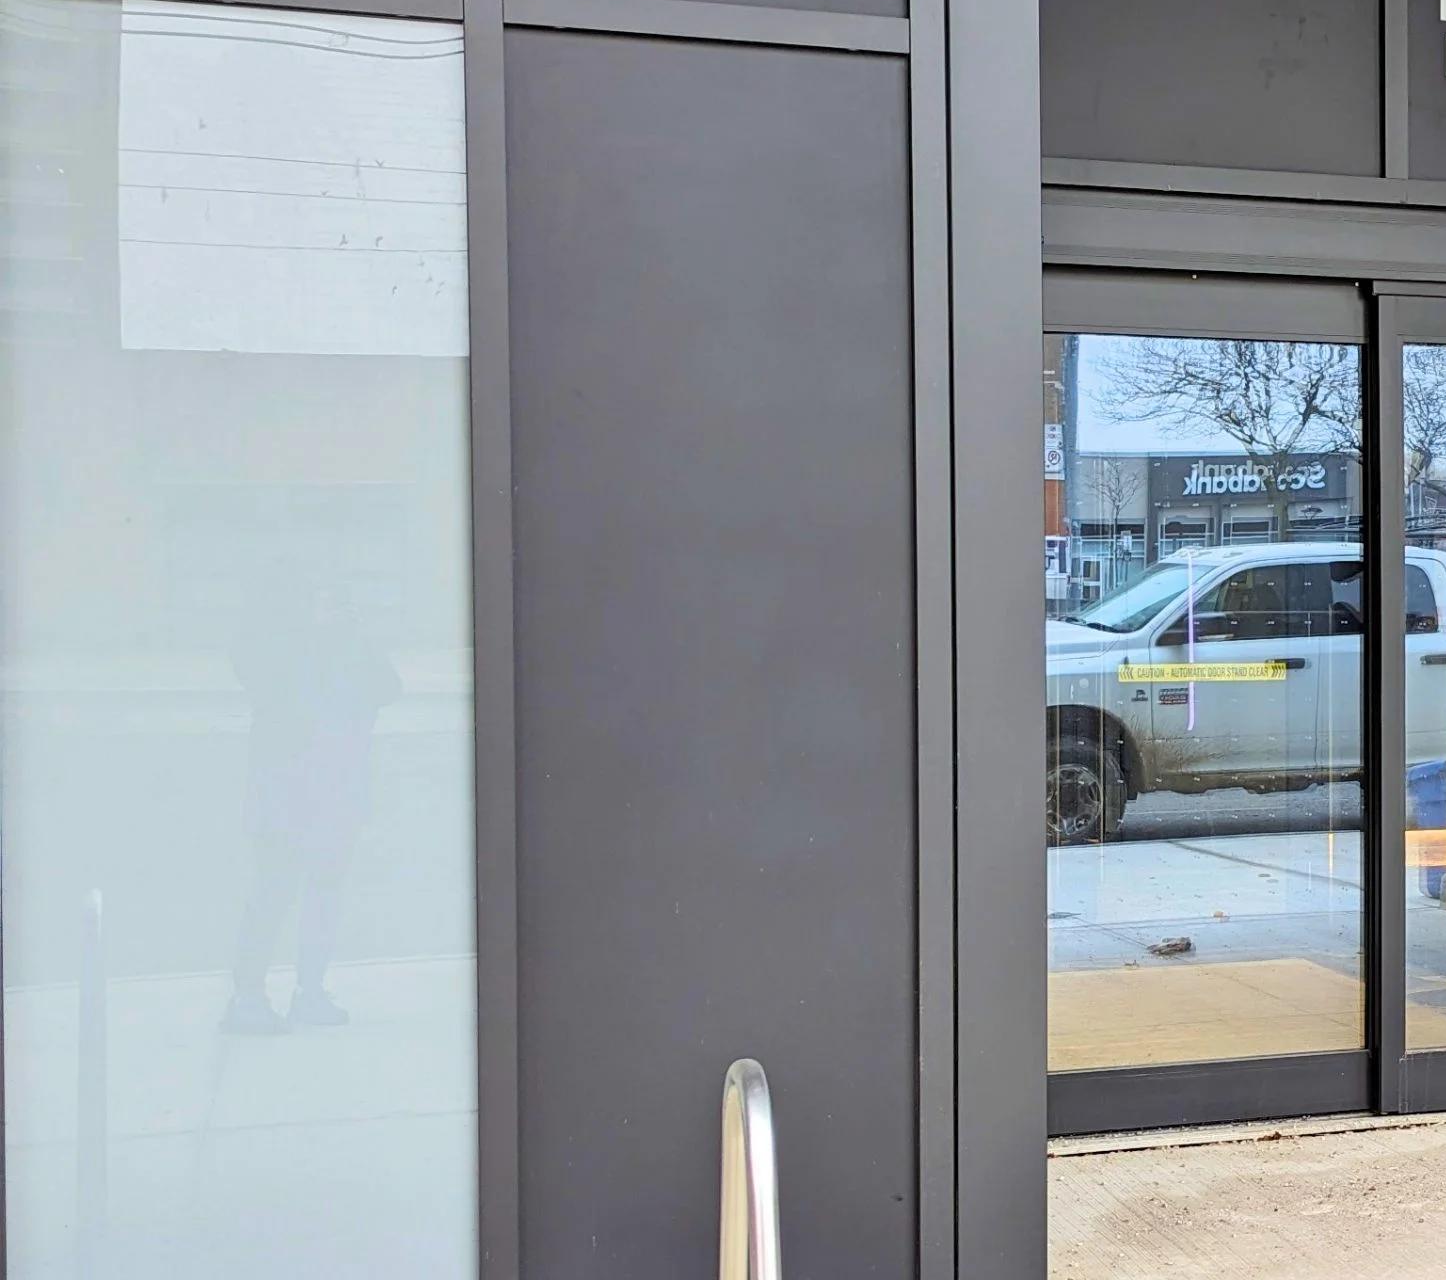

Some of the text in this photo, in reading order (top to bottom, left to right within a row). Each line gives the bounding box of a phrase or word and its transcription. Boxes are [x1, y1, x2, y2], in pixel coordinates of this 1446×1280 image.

[1137, 668, 1165, 679] CAUTION
[1171, 668, 1208, 678] AUTOMATIC
[1208, 667, 1228, 678] DOOR
[1248, 666, 1269, 677] CLEAR
